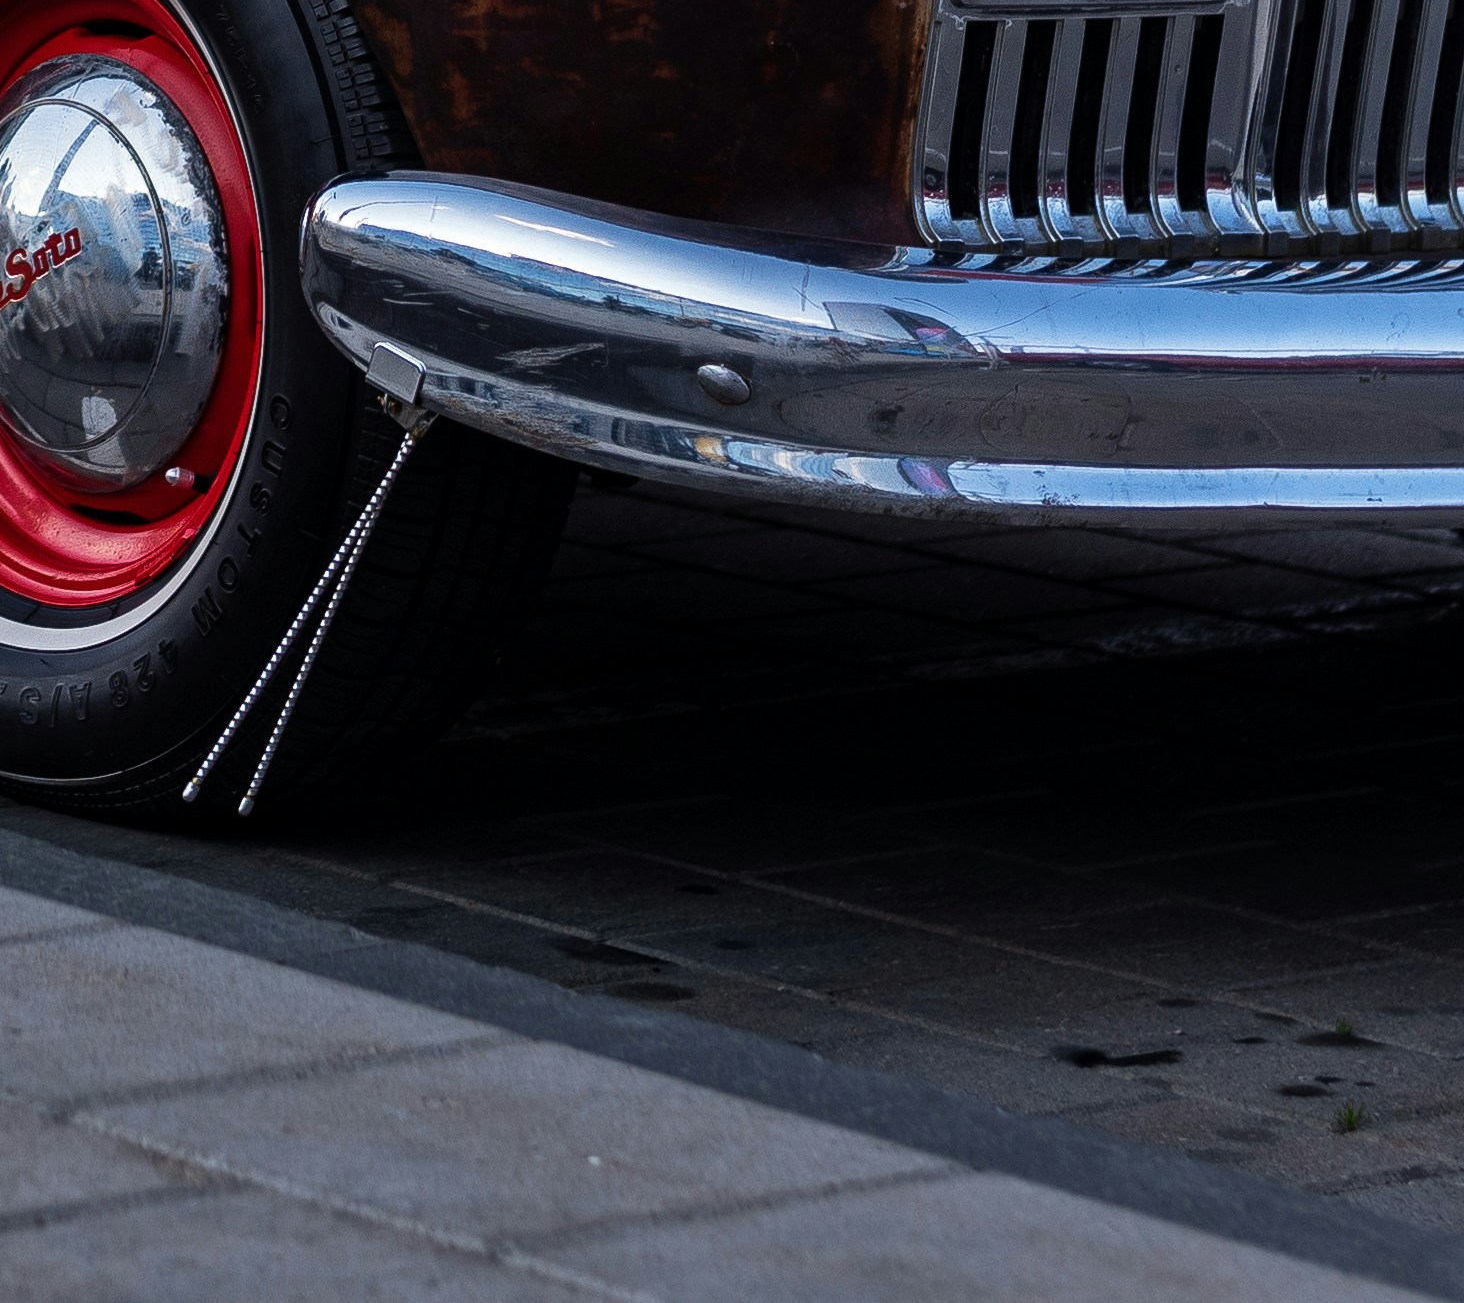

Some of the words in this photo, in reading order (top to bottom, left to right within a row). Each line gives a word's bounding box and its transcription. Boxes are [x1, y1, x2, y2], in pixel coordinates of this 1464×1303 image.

[191, 394, 293, 638] CUSTOM
[19, 680, 93, 728] A/S
[108, 637, 179, 709] 428
